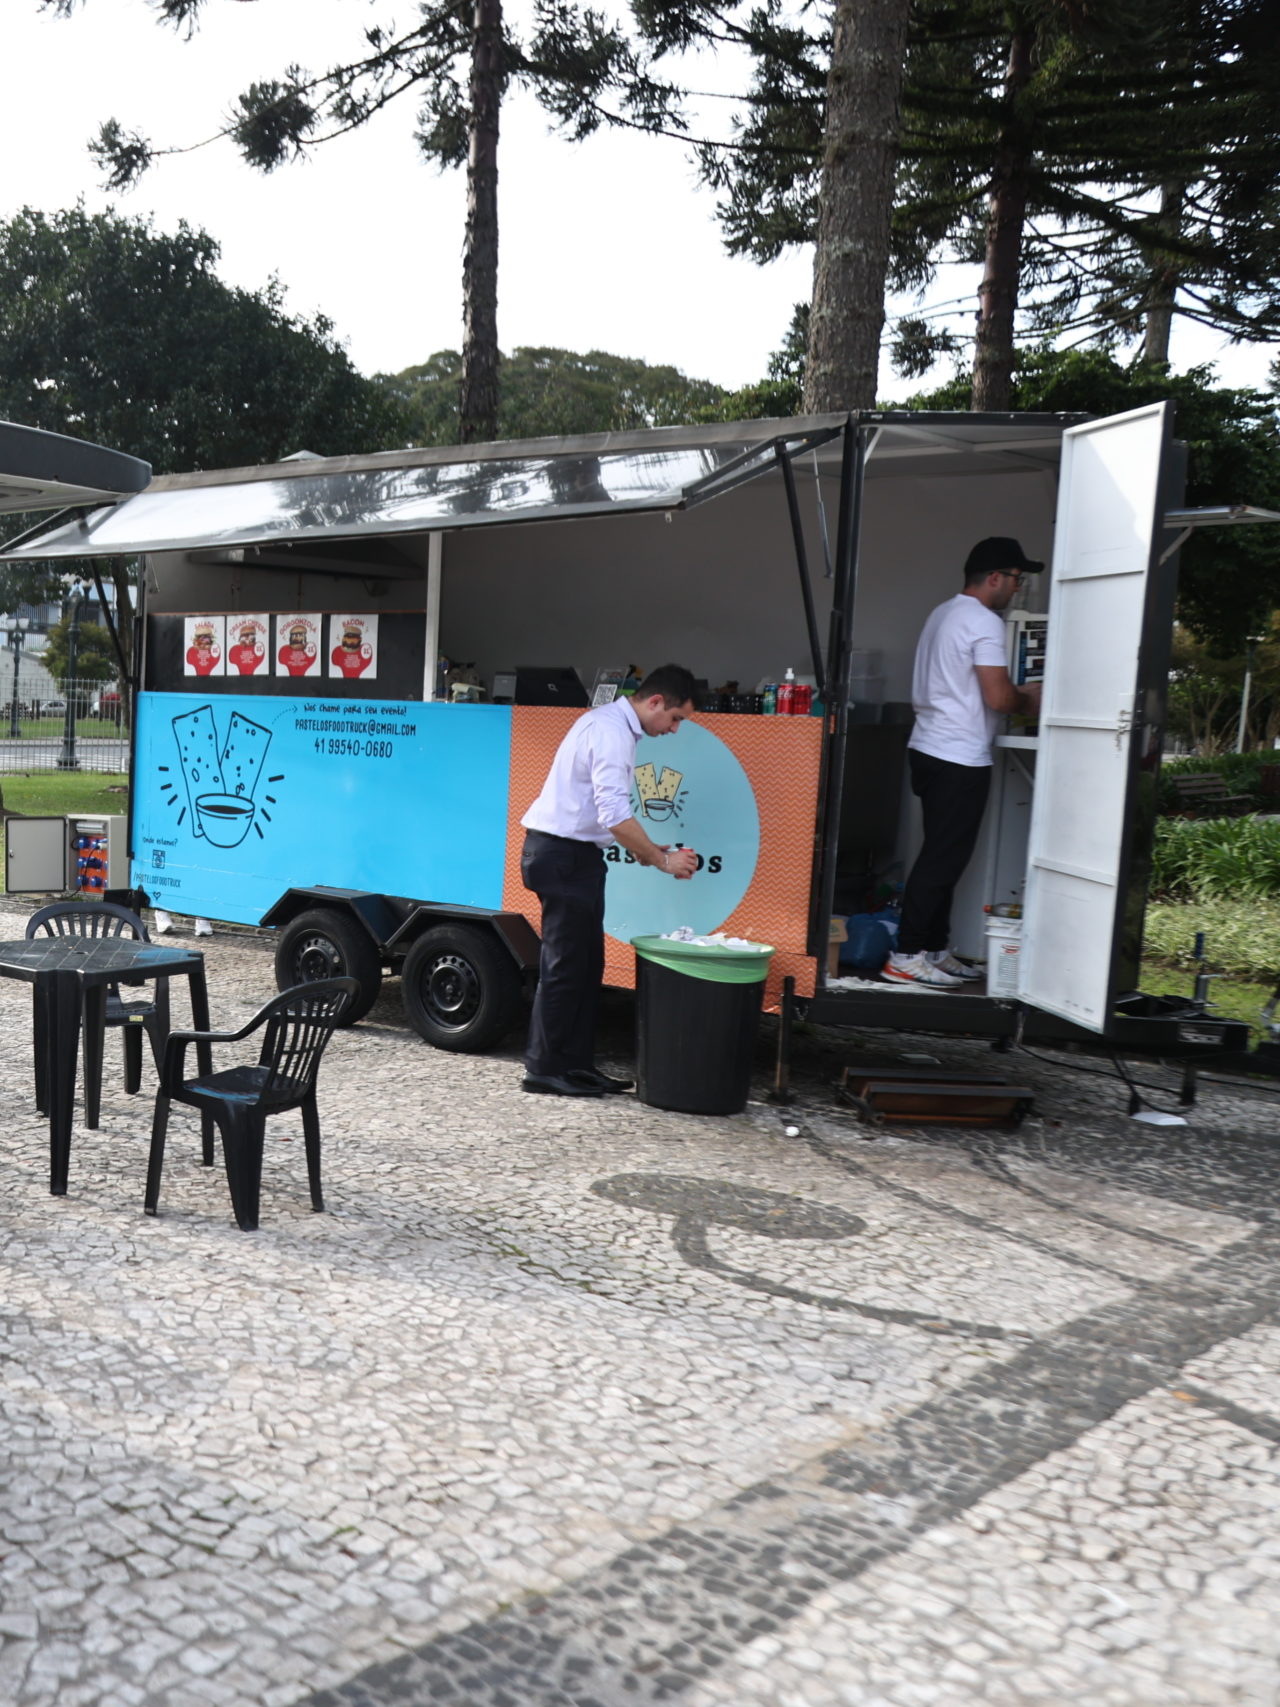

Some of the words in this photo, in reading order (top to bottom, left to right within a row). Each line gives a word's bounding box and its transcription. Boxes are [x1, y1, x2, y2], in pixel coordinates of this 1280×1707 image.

[342, 619, 365, 627] BACON
[364, 705, 378, 714] seu
[295, 718, 417, 737] PASTELOSFOODTRUCK@GMAIL.COM
[314, 738, 326, 755] 41
[328, 739, 393, 759] 99540-0680
